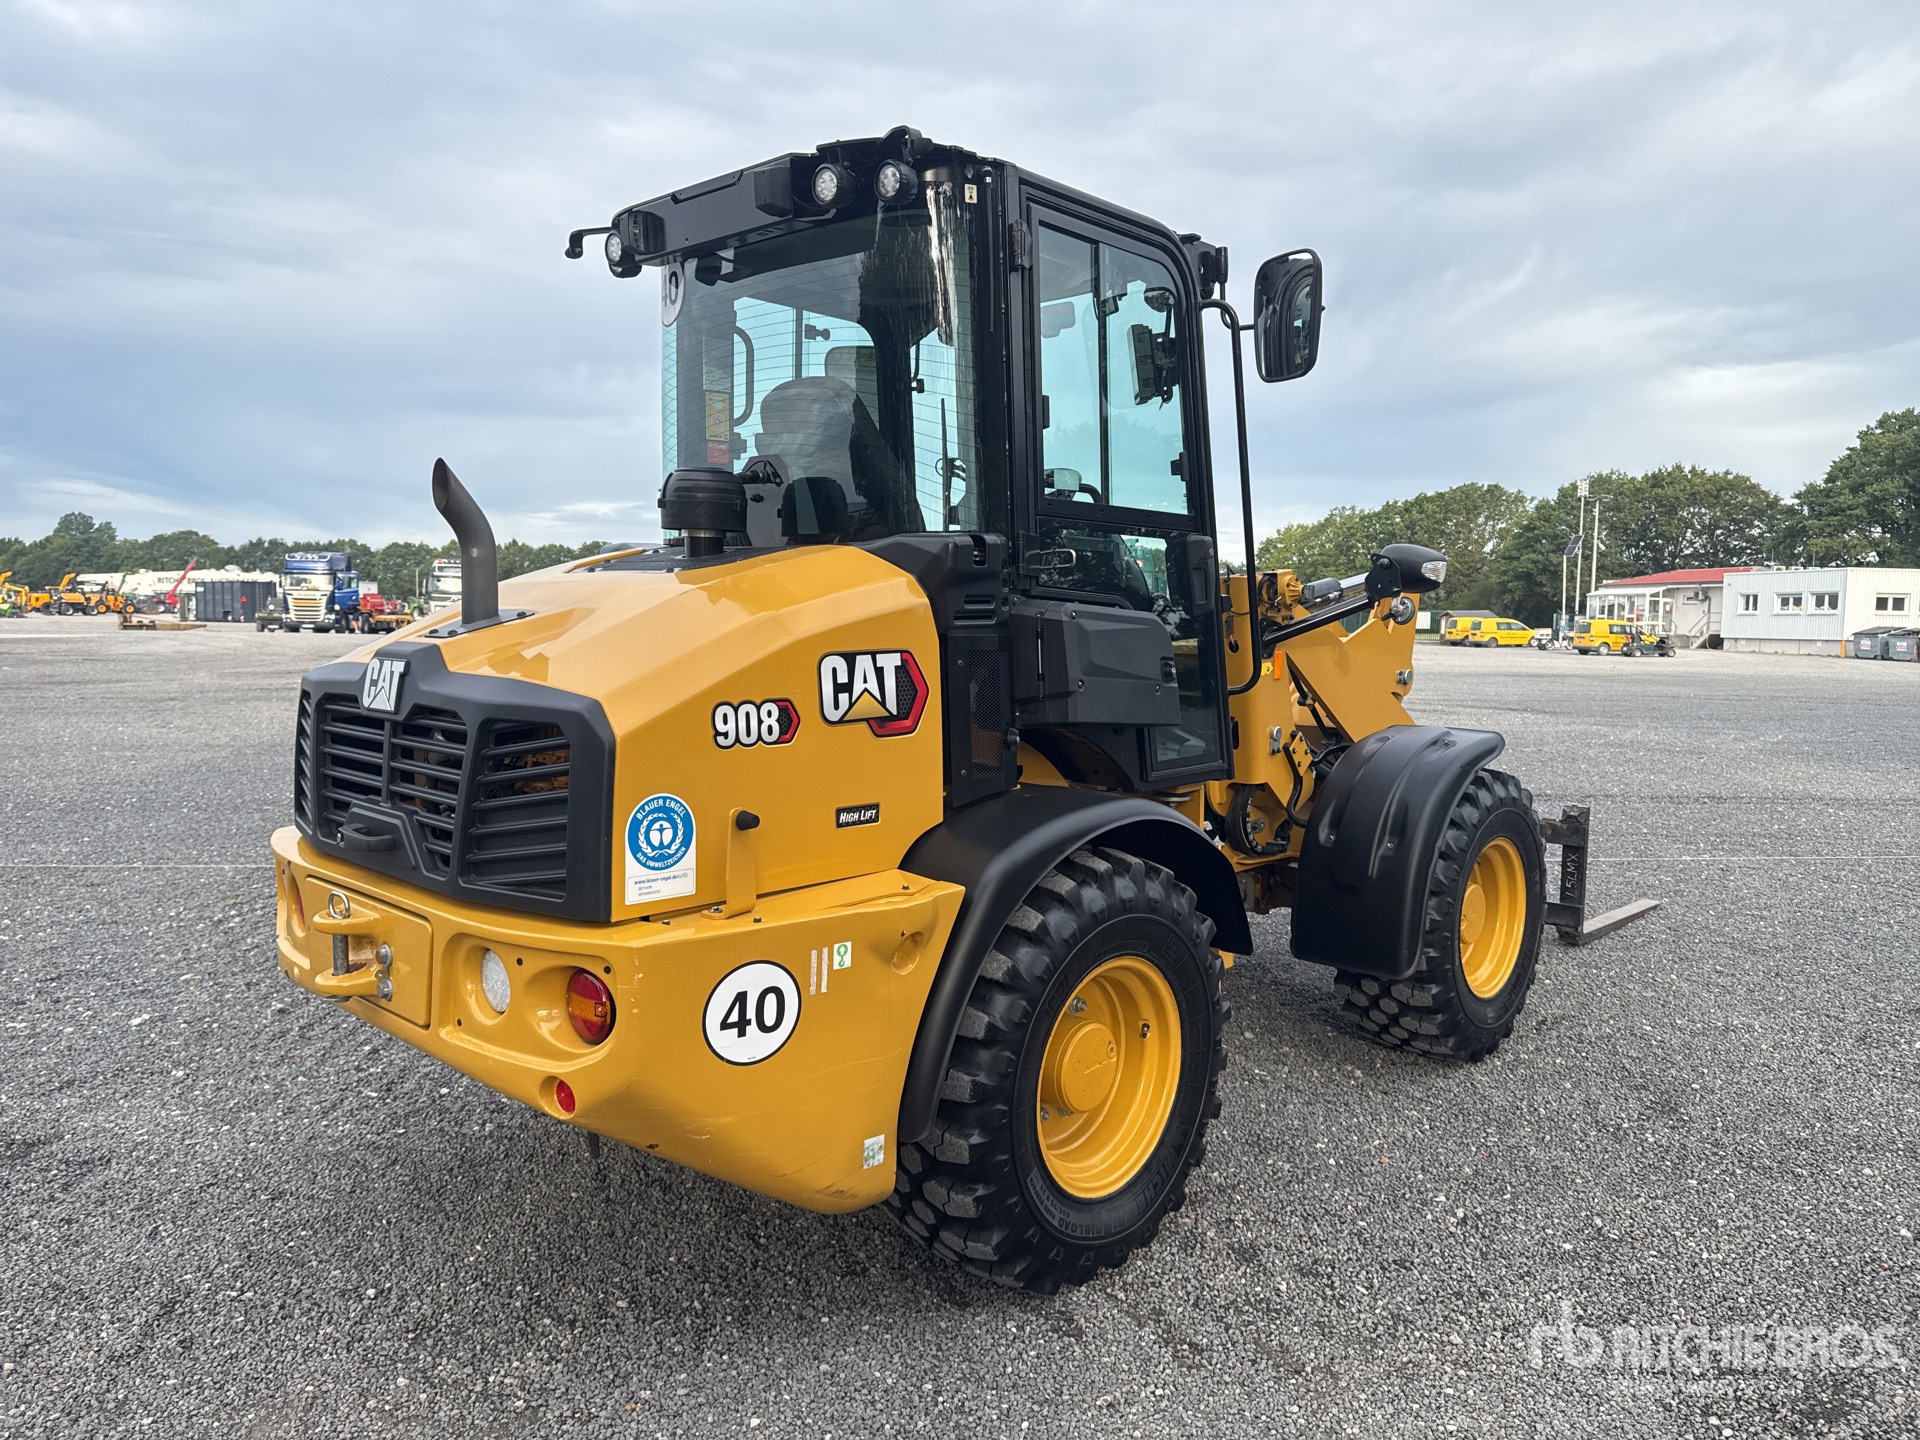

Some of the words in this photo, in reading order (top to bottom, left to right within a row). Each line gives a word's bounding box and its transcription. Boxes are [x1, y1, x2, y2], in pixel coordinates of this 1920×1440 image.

[362, 658, 406, 711] CAT
[820, 652, 902, 722] CAT
[714, 701, 780, 747] 908
[636, 798, 664, 820] BLAUER
[665, 798, 687, 819] ENGEL
[636, 852, 647, 863] DAS
[646, 846, 686, 868] UMWELTZEICHEN
[720, 985, 785, 1038] 40
